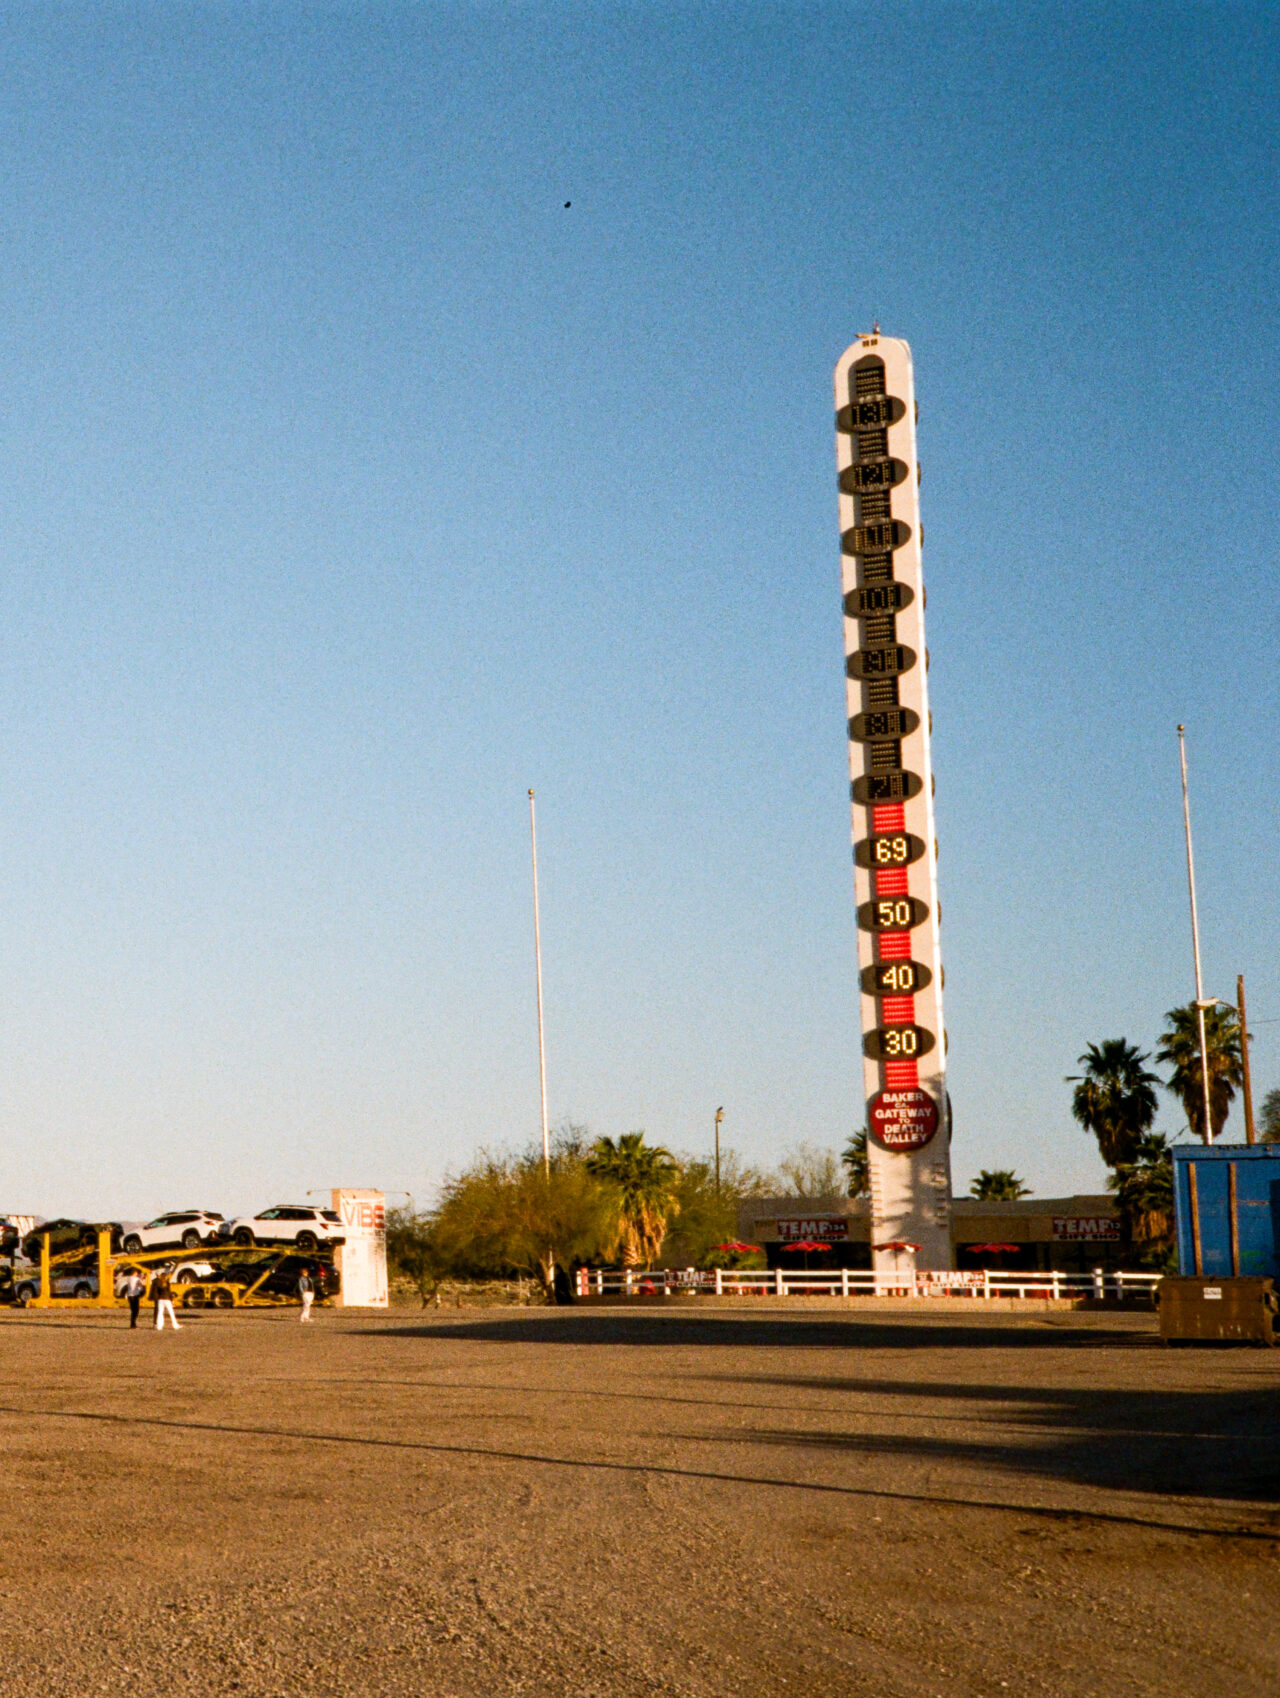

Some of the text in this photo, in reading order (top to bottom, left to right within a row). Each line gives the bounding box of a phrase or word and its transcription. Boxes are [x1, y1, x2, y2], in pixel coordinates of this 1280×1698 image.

[876, 837, 907, 862] 69
[879, 901, 910, 926] 50
[882, 965, 913, 990] 40
[885, 1029, 916, 1054] 30
[882, 1093, 924, 1103] BAKER
[875, 1108, 932, 1119] GATEWAY
[884, 1124, 924, 1134] DEATH
[883, 1134, 927, 1144] VALLEY
[778, 1221, 829, 1234] TEMP
